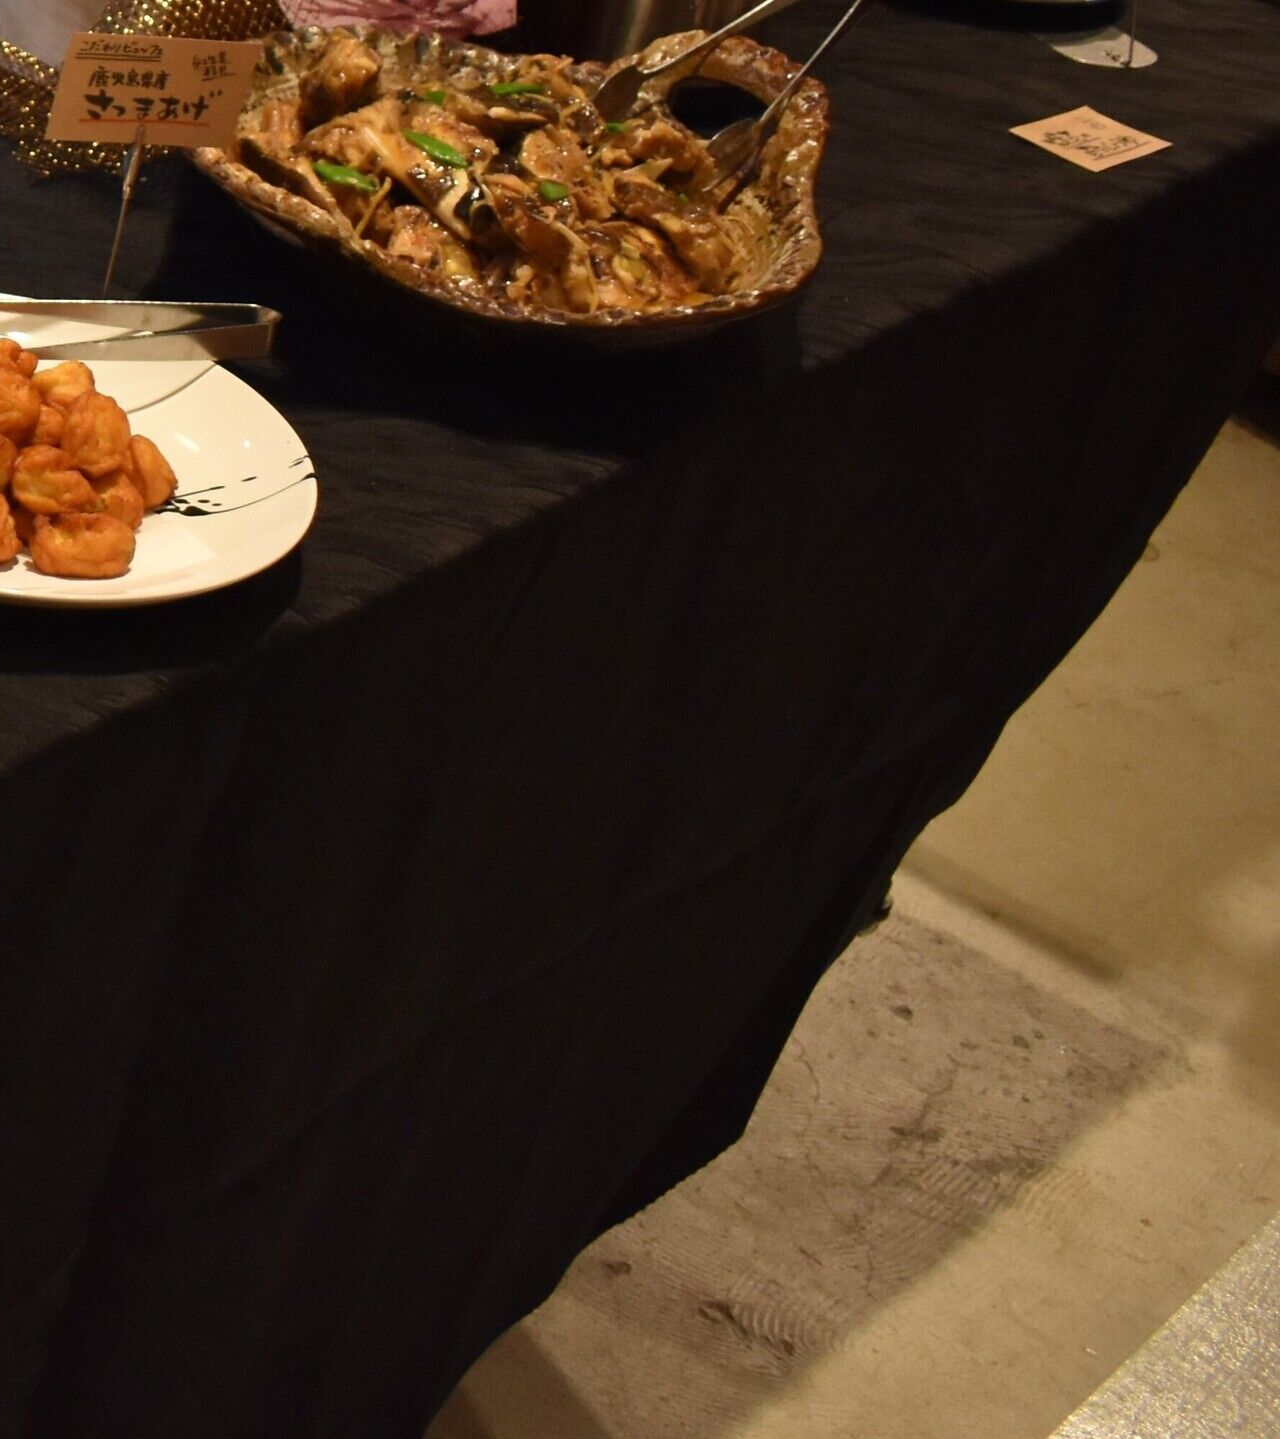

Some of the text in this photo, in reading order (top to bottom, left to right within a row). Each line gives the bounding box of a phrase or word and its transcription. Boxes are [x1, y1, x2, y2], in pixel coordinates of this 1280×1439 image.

[85, 89, 225, 121] さつまあげ
